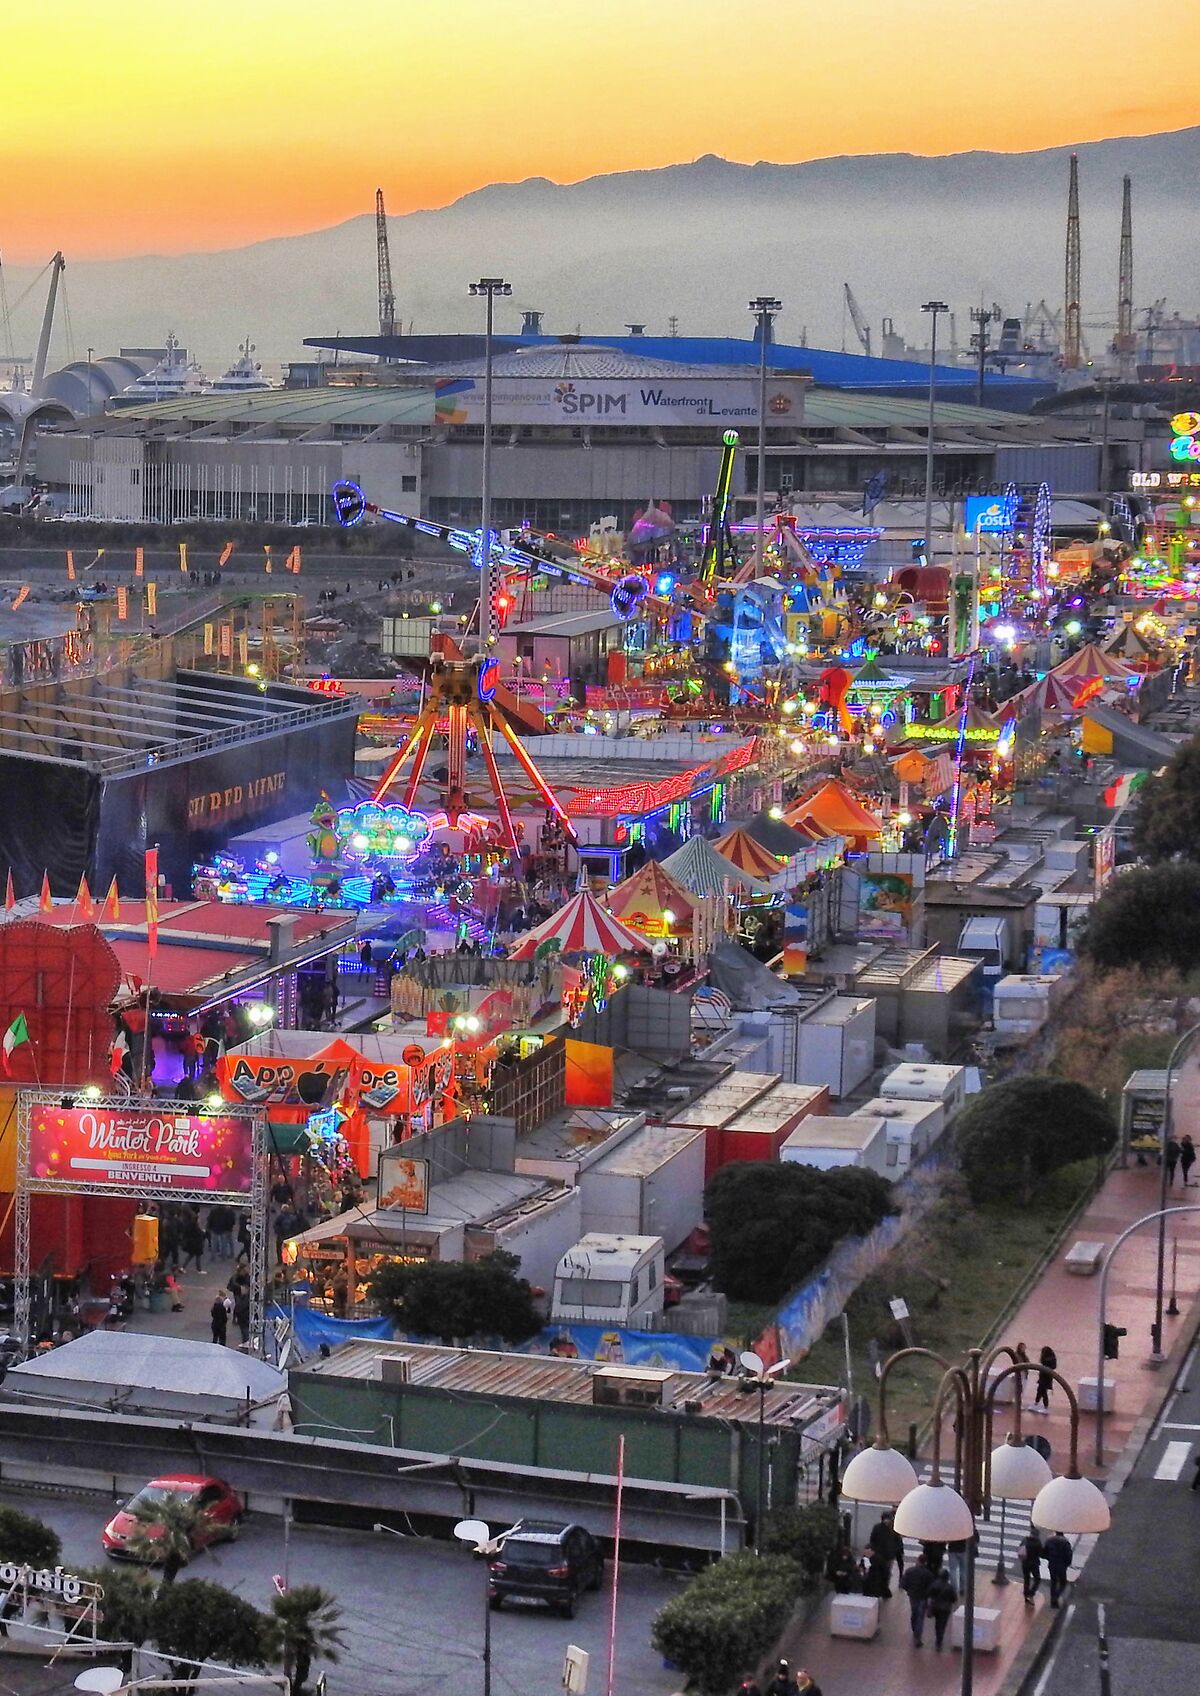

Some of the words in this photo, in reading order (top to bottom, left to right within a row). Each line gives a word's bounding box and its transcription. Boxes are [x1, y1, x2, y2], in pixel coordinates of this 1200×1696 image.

[562, 393, 626, 415] SPIM
[640, 389, 708, 407] Waterfront
[696, 406, 706, 416] di
[708, 400, 758, 416] Levante
[1132, 472, 1160, 488] OLD
[233, 1059, 295, 1088] App
[79, 1113, 150, 1153] Winter
[145, 1118, 202, 1158] Park
[123, 1150, 137, 1160] Park
[122, 1163, 151, 1171] INGRESSO
[108, 1171, 172, 1183] BENVENUTI
